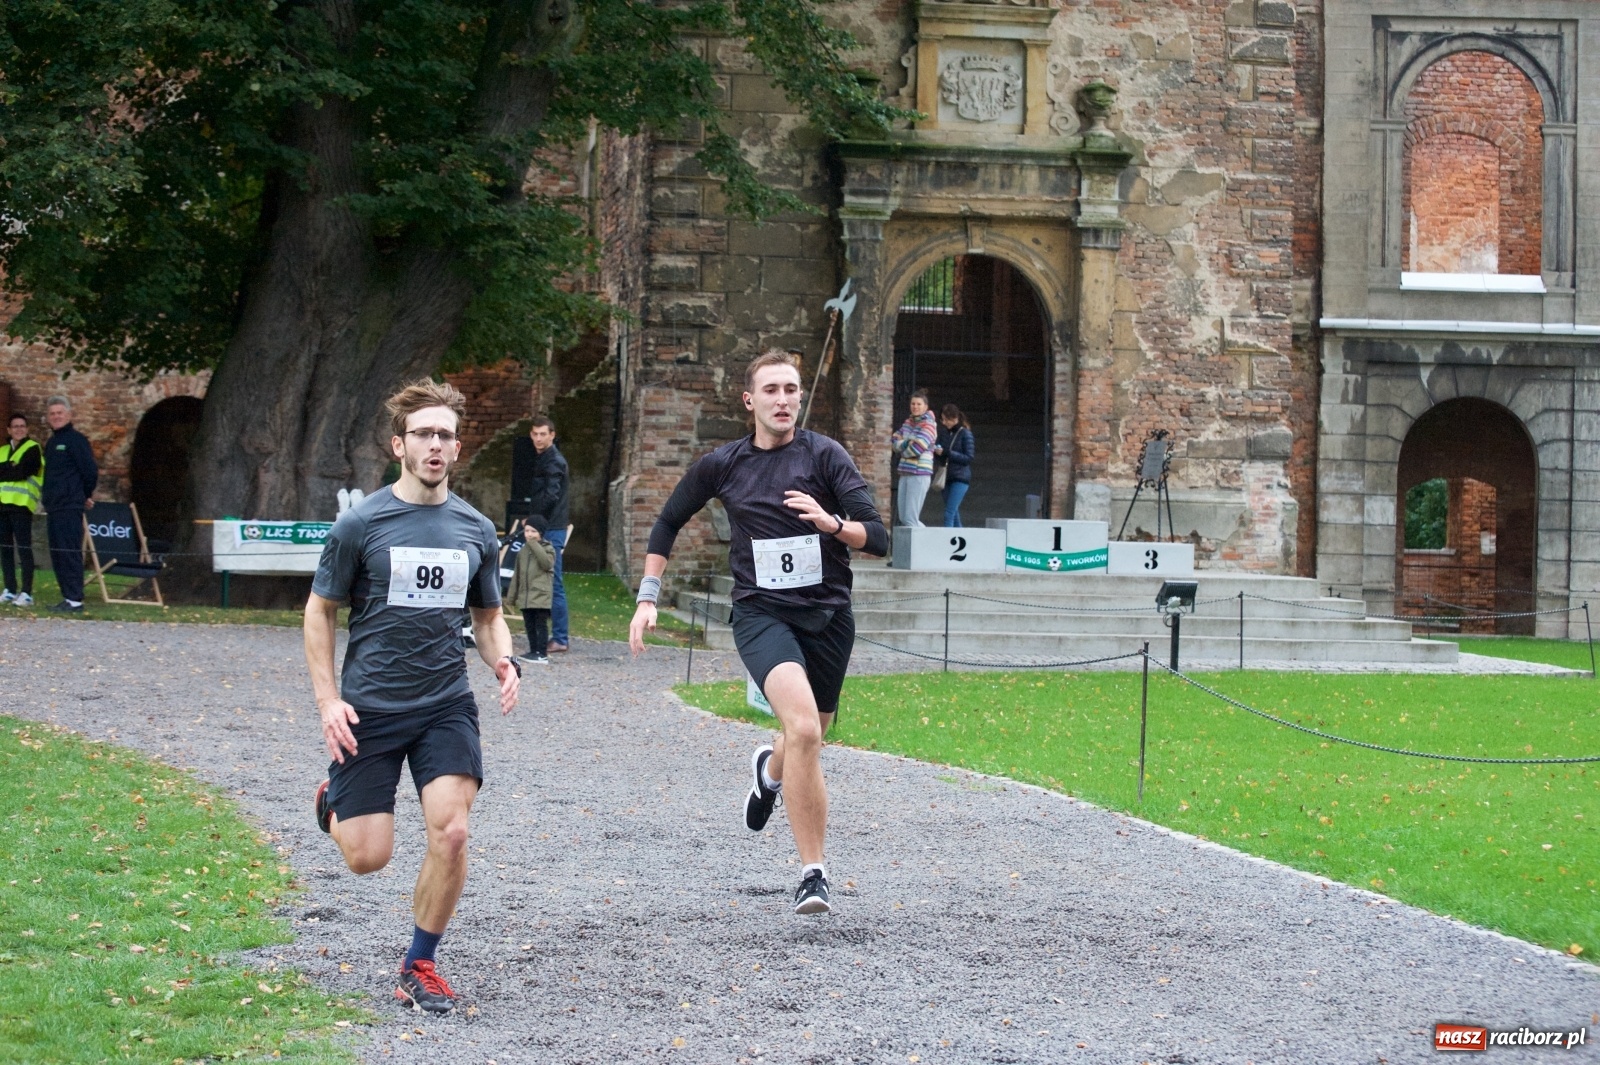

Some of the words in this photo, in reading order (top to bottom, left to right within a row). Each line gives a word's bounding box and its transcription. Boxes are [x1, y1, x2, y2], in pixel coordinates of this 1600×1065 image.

[88, 520, 132, 538] safer
[265, 527, 293, 538] LKS
[297, 528, 330, 539] TWO
[1051, 526, 1063, 551] 1
[949, 536, 967, 562] 2
[1006, 552, 1021, 562] LKS
[1024, 556, 1041, 565] 1905
[1066, 553, 1107, 566] TWORKÓW
[780, 552, 794, 574] 8
[1144, 550, 1159, 570] 3
[416, 565, 444, 590] 98
